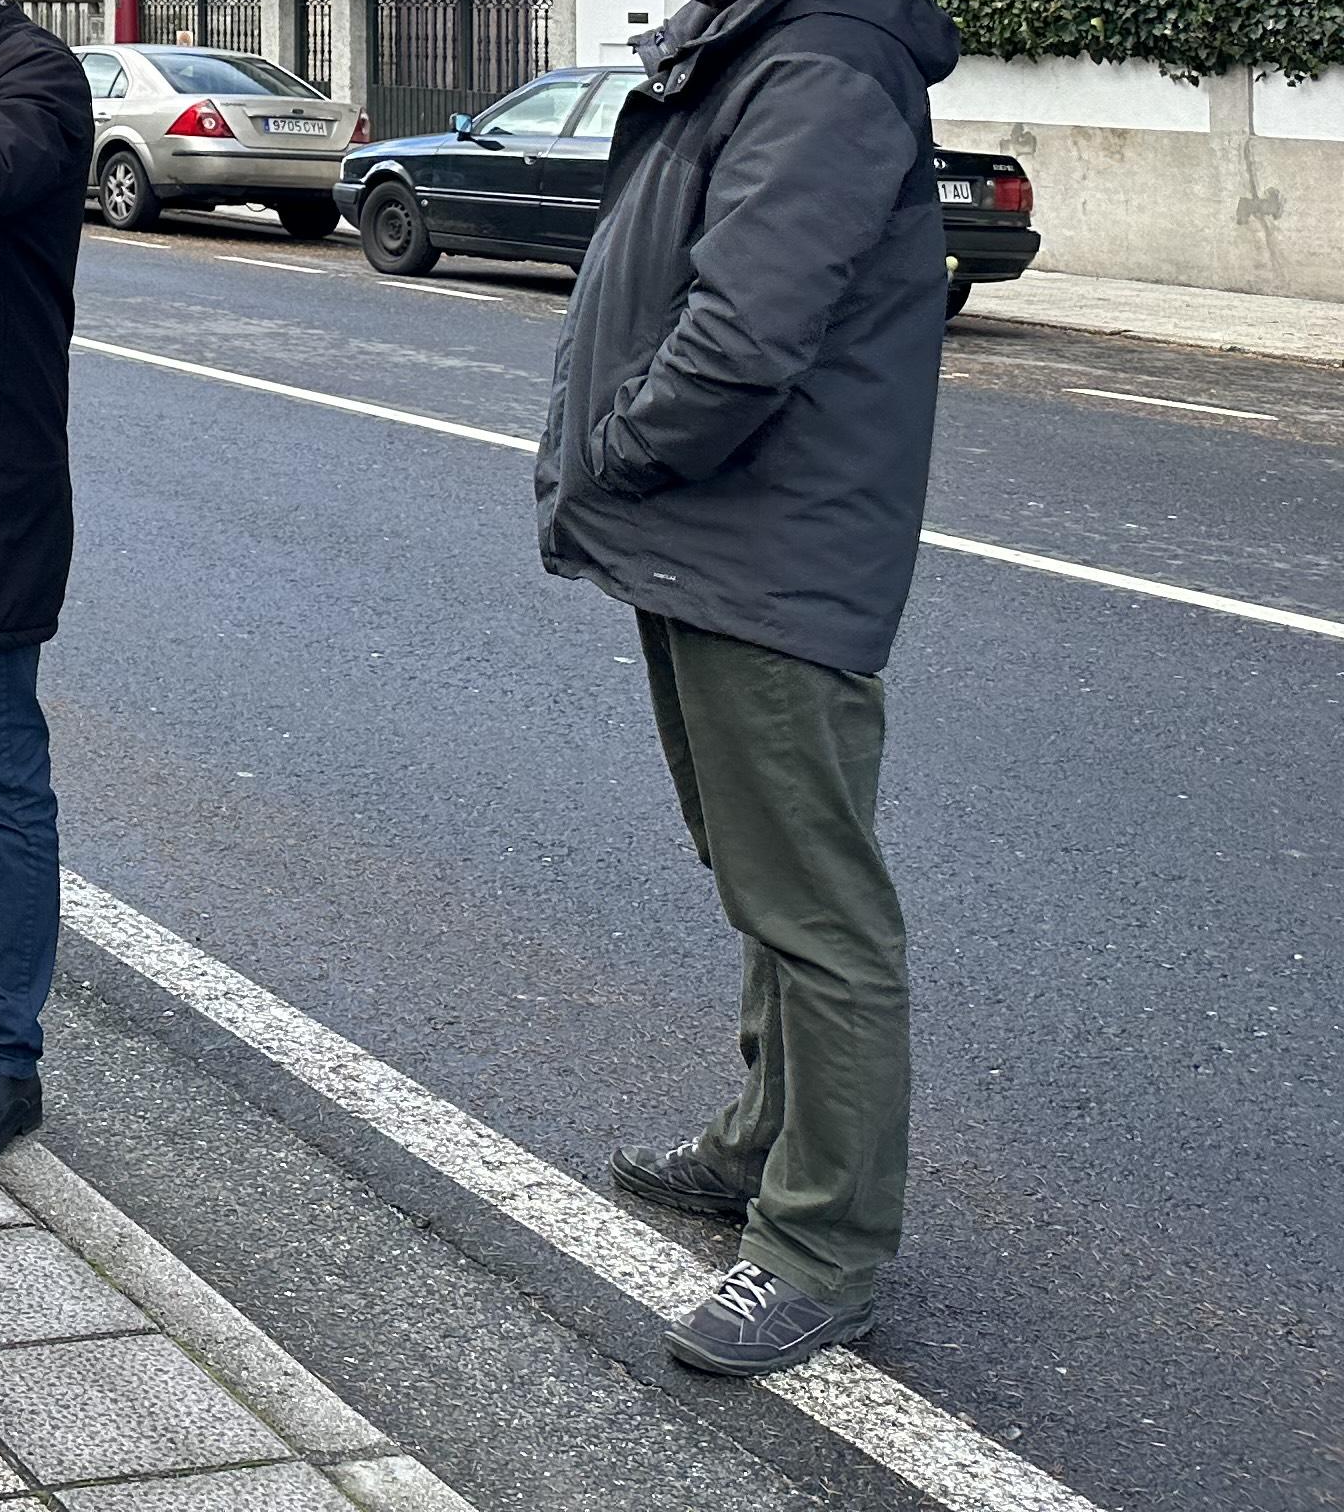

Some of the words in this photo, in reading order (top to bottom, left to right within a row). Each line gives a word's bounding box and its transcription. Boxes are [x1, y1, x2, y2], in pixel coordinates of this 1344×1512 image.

[273, 119, 302, 132] 9705
[303, 121, 325, 134] CYH
[953, 183, 970, 200] AU
